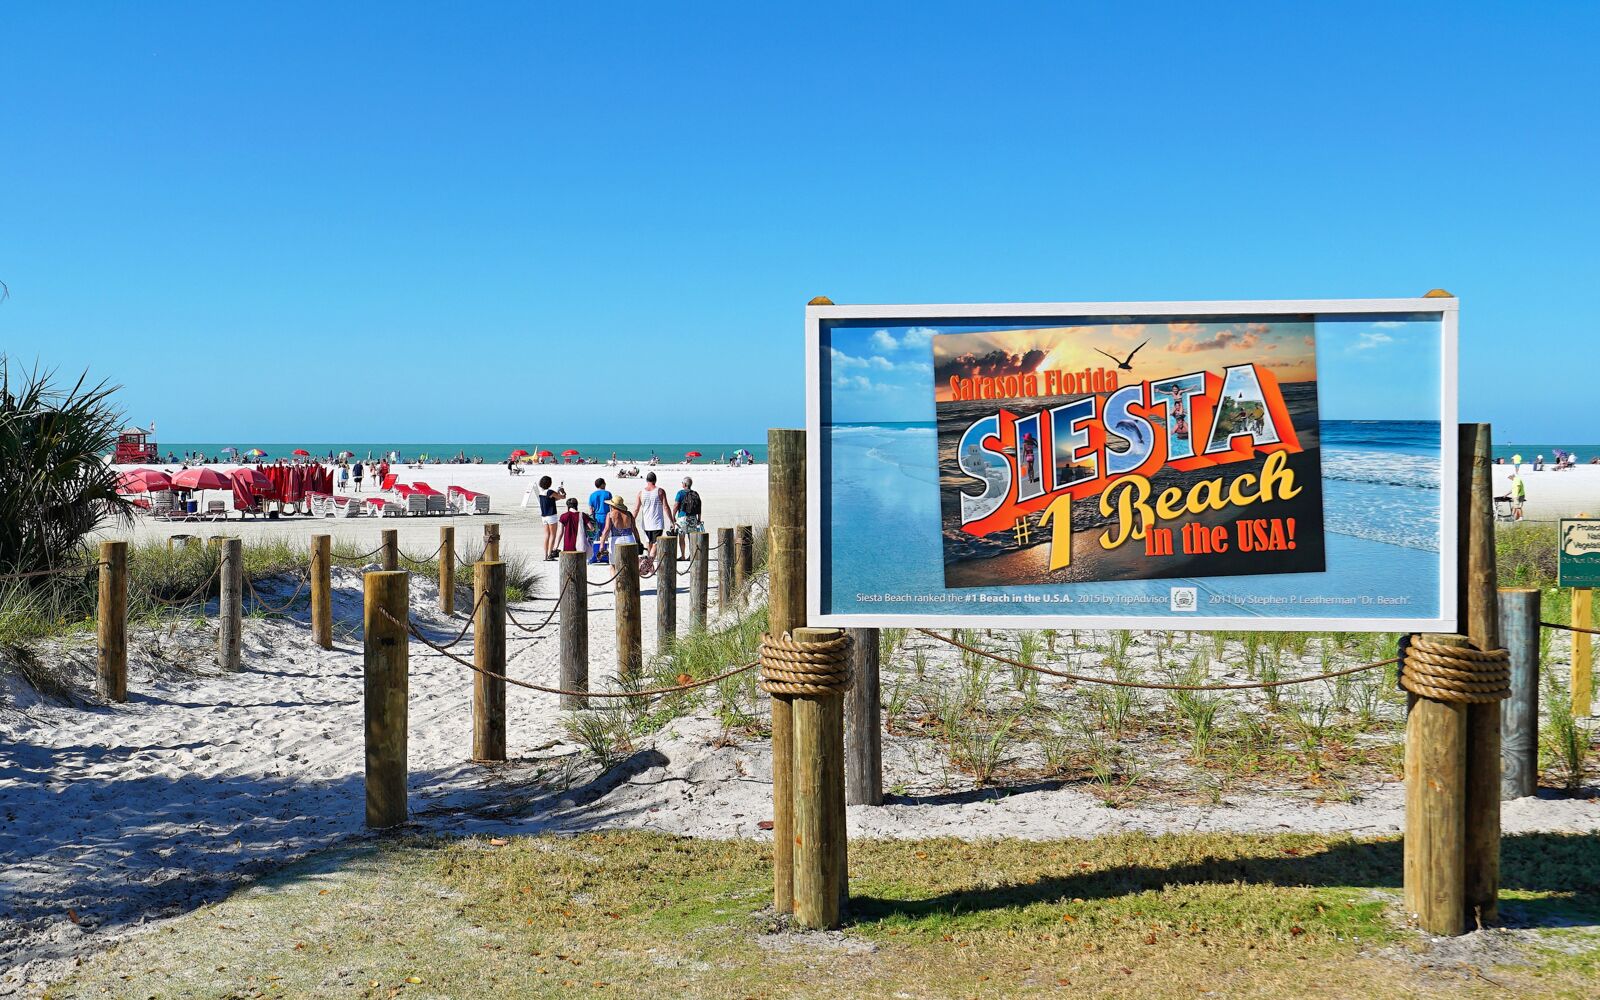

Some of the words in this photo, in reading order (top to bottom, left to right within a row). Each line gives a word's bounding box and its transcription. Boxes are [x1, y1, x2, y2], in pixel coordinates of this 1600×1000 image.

[950, 371, 1038, 401] Sarasota
[1043, 367, 1118, 397] Florida
[957, 362, 1288, 532] SIESTA
[1012, 492, 1071, 573] #1
[1099, 450, 1303, 550] Beach
[1145, 526, 1174, 557] in
[1182, 522, 1229, 555] the
[1236, 517, 1297, 552] USA!
[856, 592, 883, 603] Siesta
[884, 592, 912, 603] Beach
[914, 593, 946, 603] ranked
[947, 593, 965, 603] the
[964, 593, 978, 603] #1
[979, 593, 1010, 604] Beach
[1011, 593, 1022, 604] in
[1023, 593, 1041, 604] the
[1042, 593, 1074, 604] U.S.A.
[1077, 594, 1101, 604] 2015
[1102, 594, 1114, 606] by
[1115, 594, 1169, 606] TripAdvisor
[1208, 594, 1231, 605] 2011
[1234, 594, 1246, 606] by
[1247, 594, 1288, 606] Stephen
[1289, 594, 1298, 605] P.
[1299, 595, 1356, 605] Leatherman
